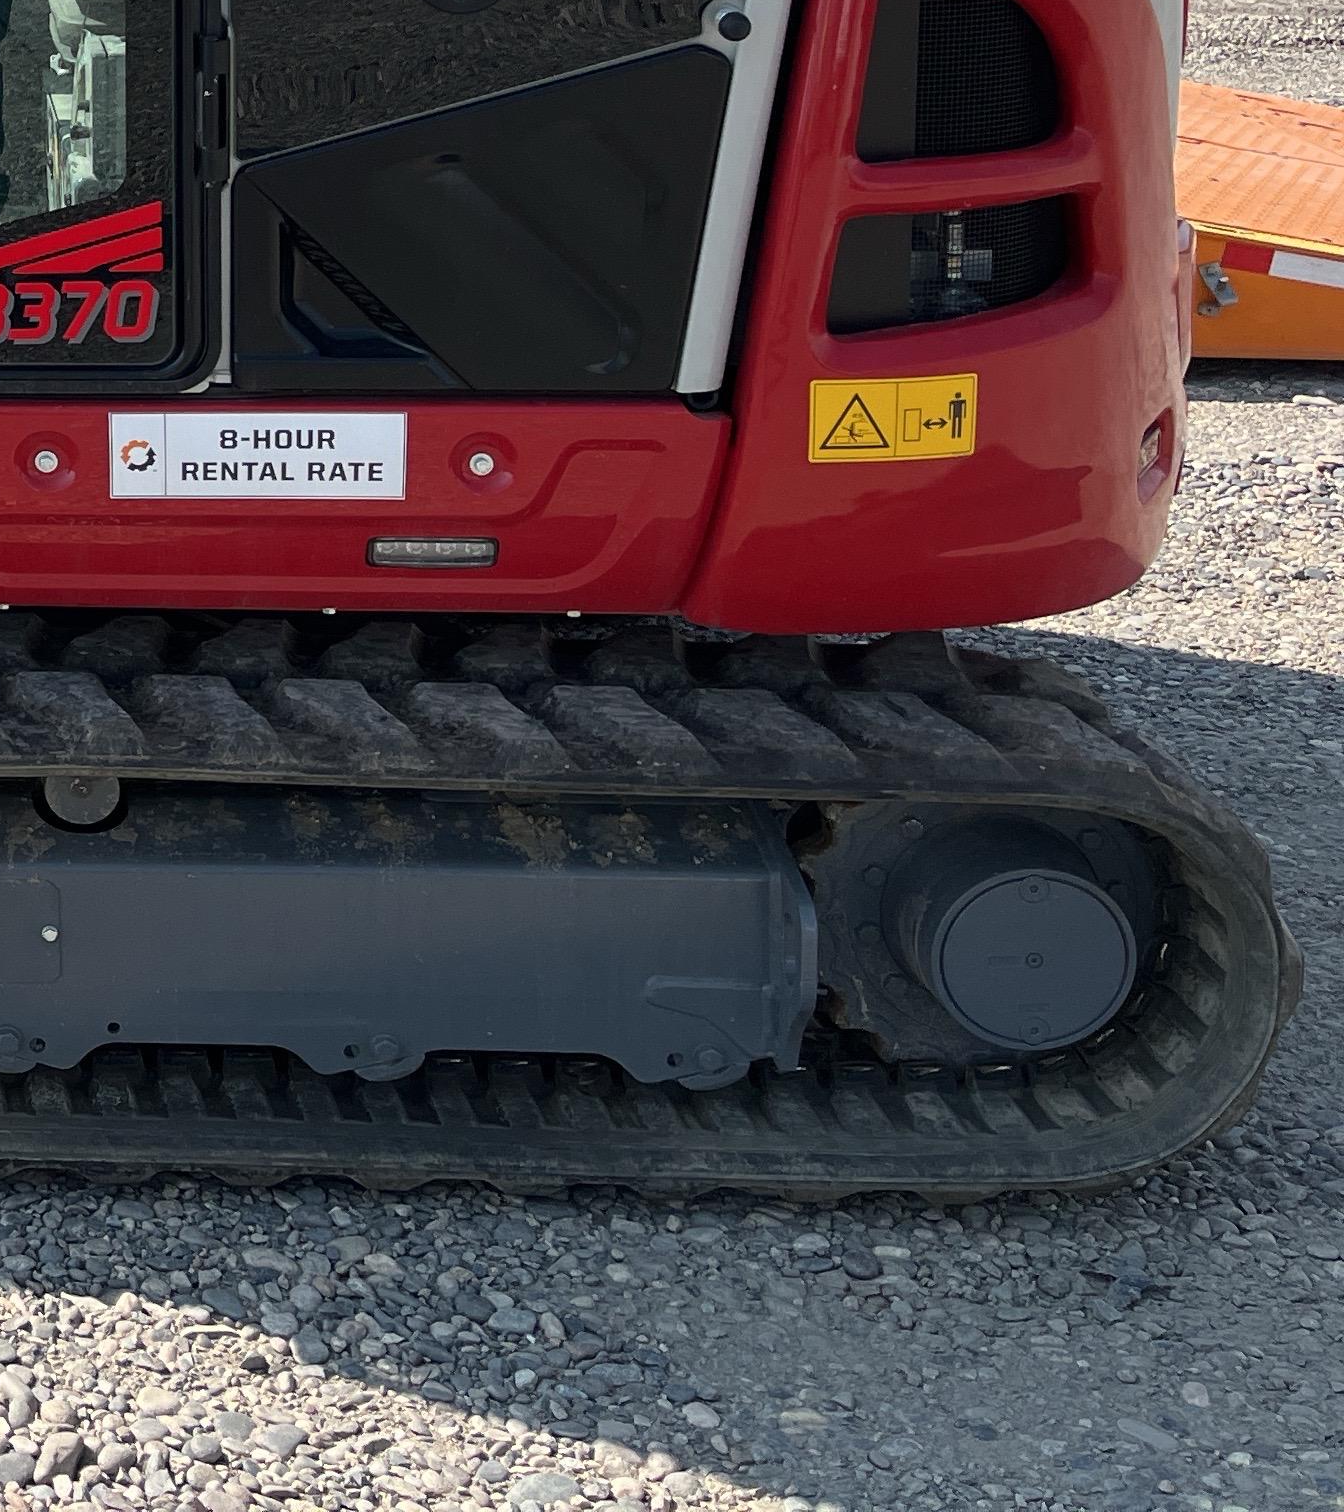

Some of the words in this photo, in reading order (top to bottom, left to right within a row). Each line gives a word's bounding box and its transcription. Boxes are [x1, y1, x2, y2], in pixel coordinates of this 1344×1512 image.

[219, 429, 336, 450] 8-HOUR
[181, 461, 295, 481] RENTAL
[307, 462, 384, 482] RATE
